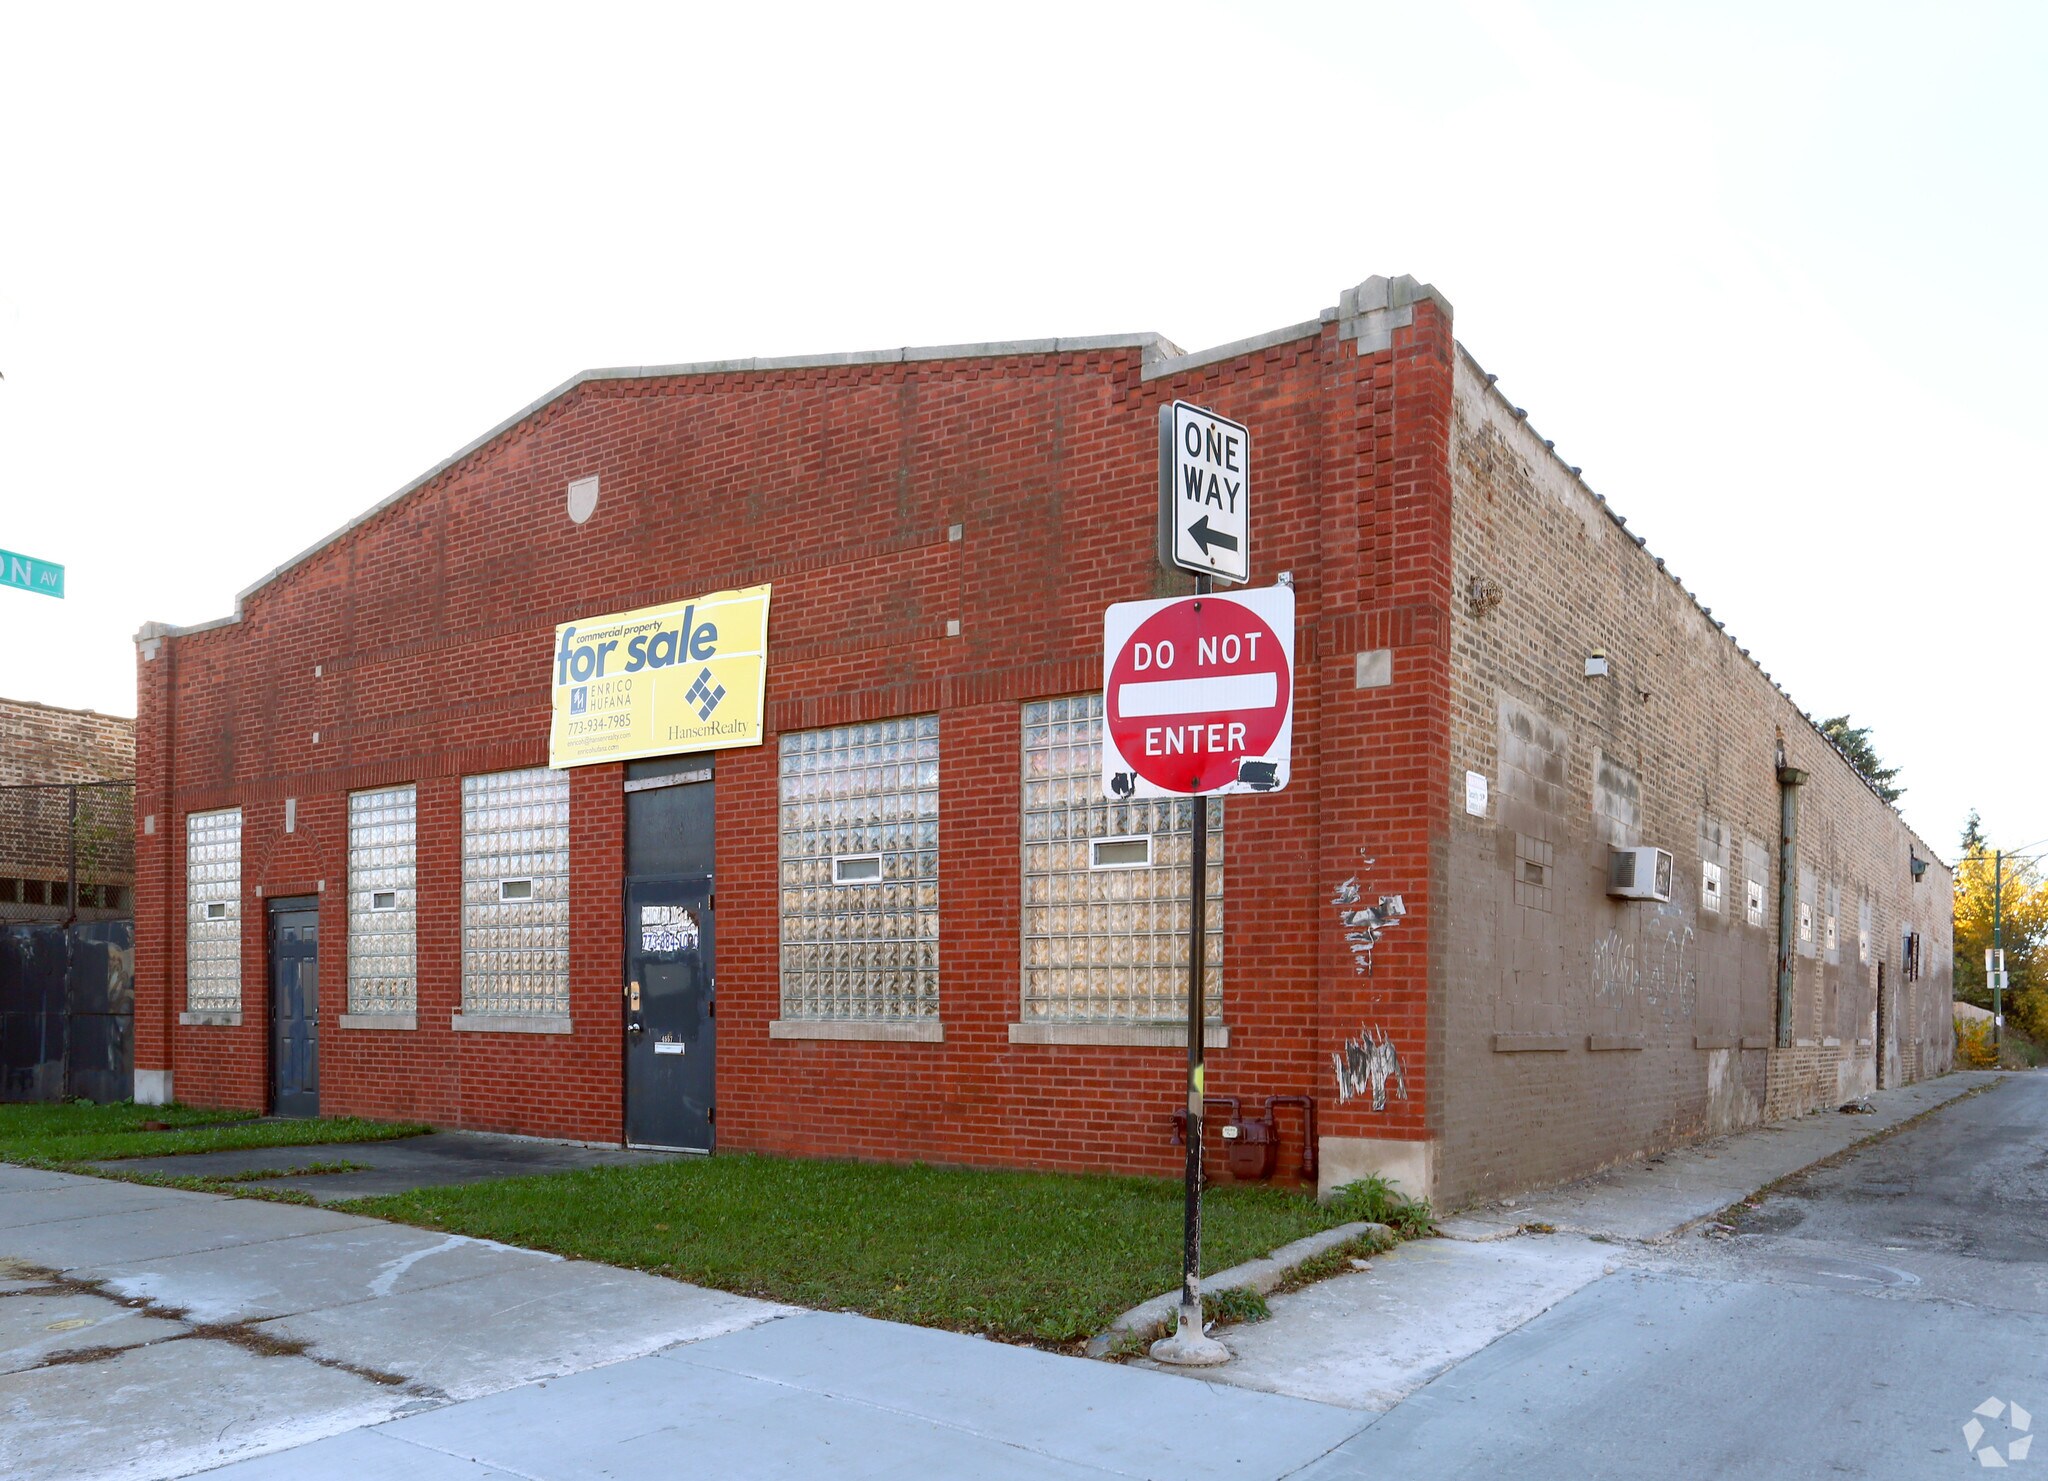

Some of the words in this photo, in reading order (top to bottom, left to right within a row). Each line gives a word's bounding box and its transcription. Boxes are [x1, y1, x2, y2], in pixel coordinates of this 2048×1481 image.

[1184, 421, 1239, 473] ONE
[1183, 464, 1241, 515] WAY
[40, 571, 58, 587] AV
[558, 627, 619, 686] for
[625, 605, 718, 673] sale
[577, 625, 623, 644] commercial
[624, 620, 663, 638] property
[1134, 639, 1175, 672] DO
[1198, 631, 1262, 667] NOT
[591, 678, 633, 697] ENRICO
[591, 693, 631, 711] HUFANA
[568, 713, 631, 736] 773-934-7985
[1145, 721, 1247, 756] ENTER
